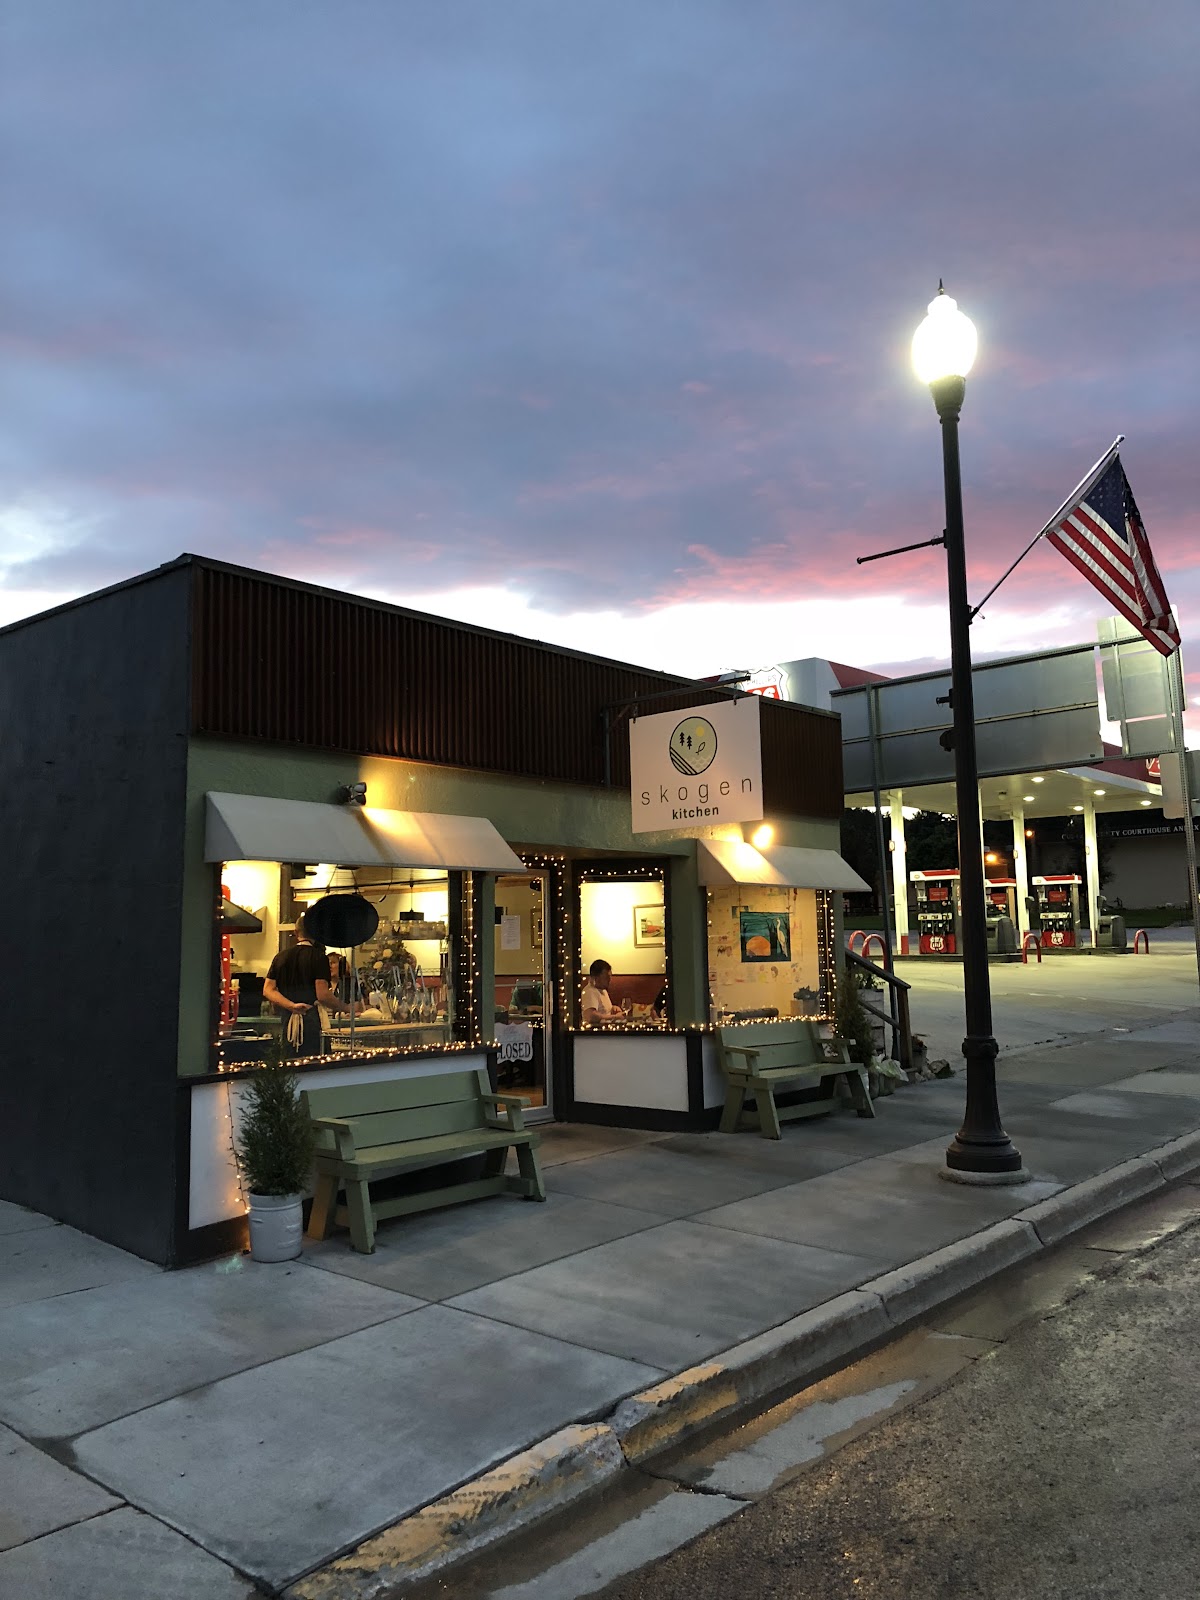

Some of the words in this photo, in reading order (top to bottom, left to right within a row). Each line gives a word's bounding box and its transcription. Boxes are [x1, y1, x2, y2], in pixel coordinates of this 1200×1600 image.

[641, 778, 752, 806] skogen
[672, 806, 719, 820] kitchen
[1122, 826, 1171, 836] COURTHOUSE
[1173, 824, 1200, 833] ANX
[497, 1042, 531, 1060] LOSED
